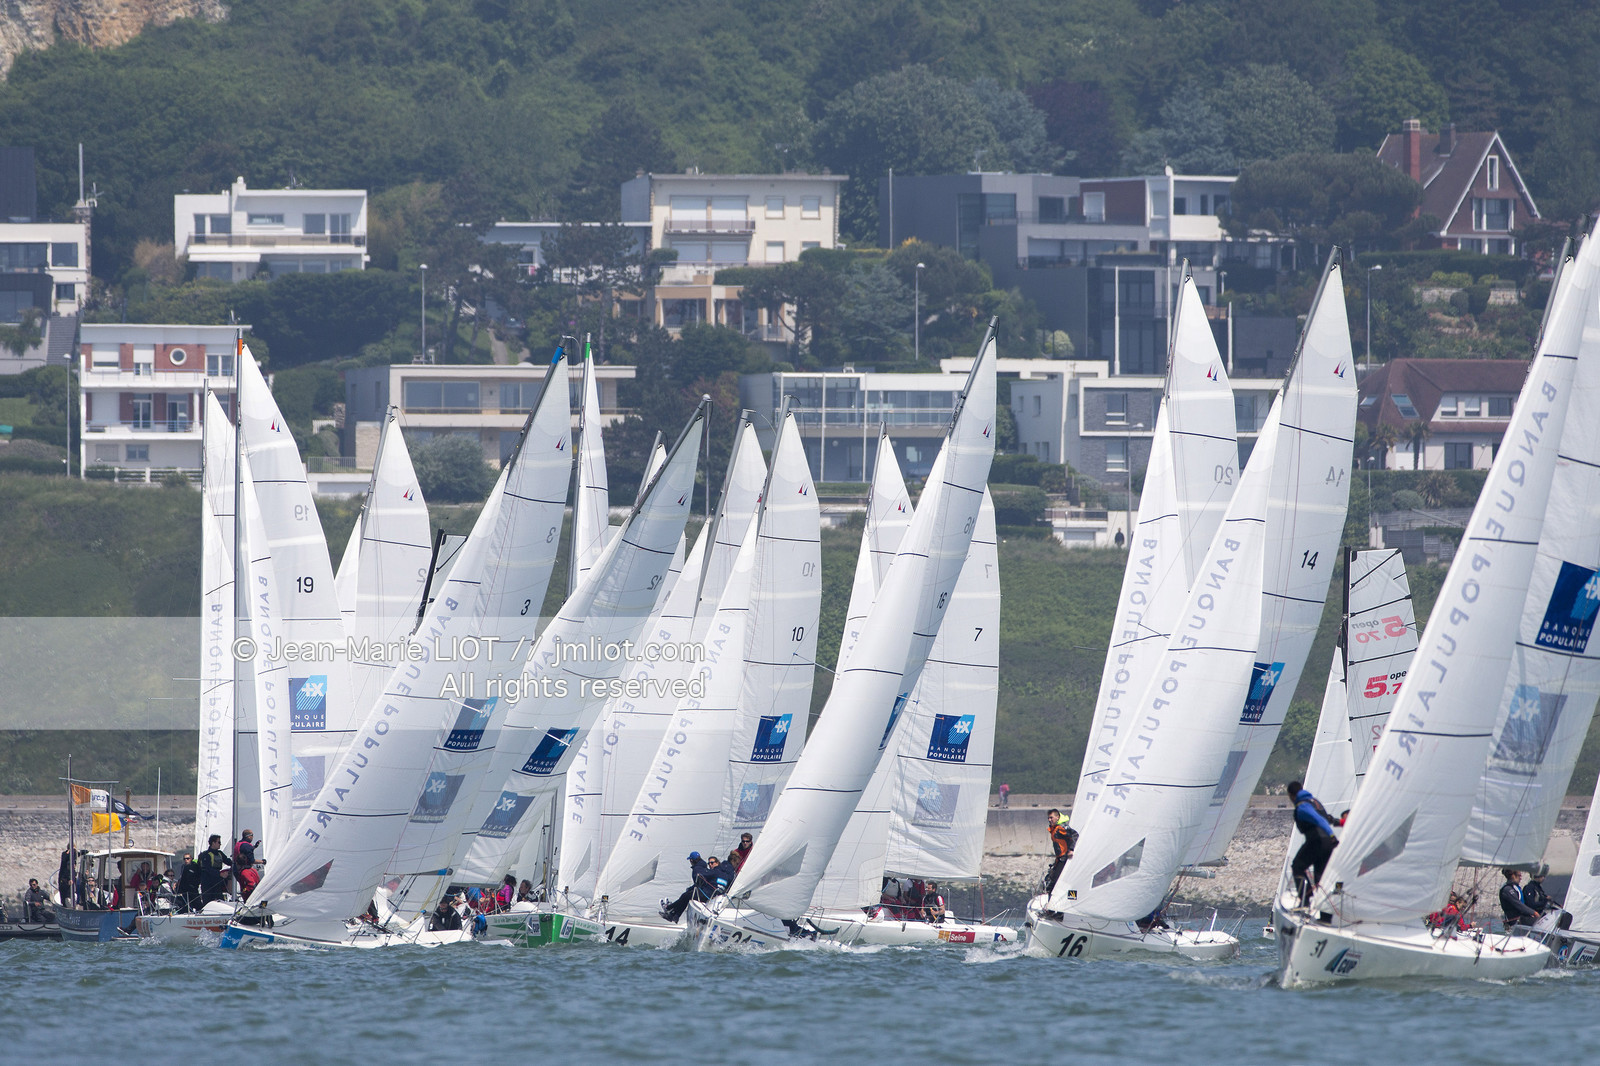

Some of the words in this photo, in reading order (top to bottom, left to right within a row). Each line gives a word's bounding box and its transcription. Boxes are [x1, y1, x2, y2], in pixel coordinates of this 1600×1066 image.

[1301, 550, 1319, 570] 14
[296, 576, 314, 594] 19
[520, 598, 531, 616] 3
[791, 626, 804, 642] 10
[974, 627, 983, 642] 7
[1543, 620, 1591, 638] BANQUE
[1539, 632, 1587, 649] POPULARE
[1390, 670, 1407, 681] ope
[1363, 674, 1403, 699] 5.7
[1240, 712, 1262, 720] ULAIRE
[1244, 704, 1266, 712] NQUE
[929, 751, 966, 761] POPULAIRE
[930, 745, 966, 754] BANQUE
[604, 925, 631, 947] 14
[1057, 932, 1089, 958] 16
